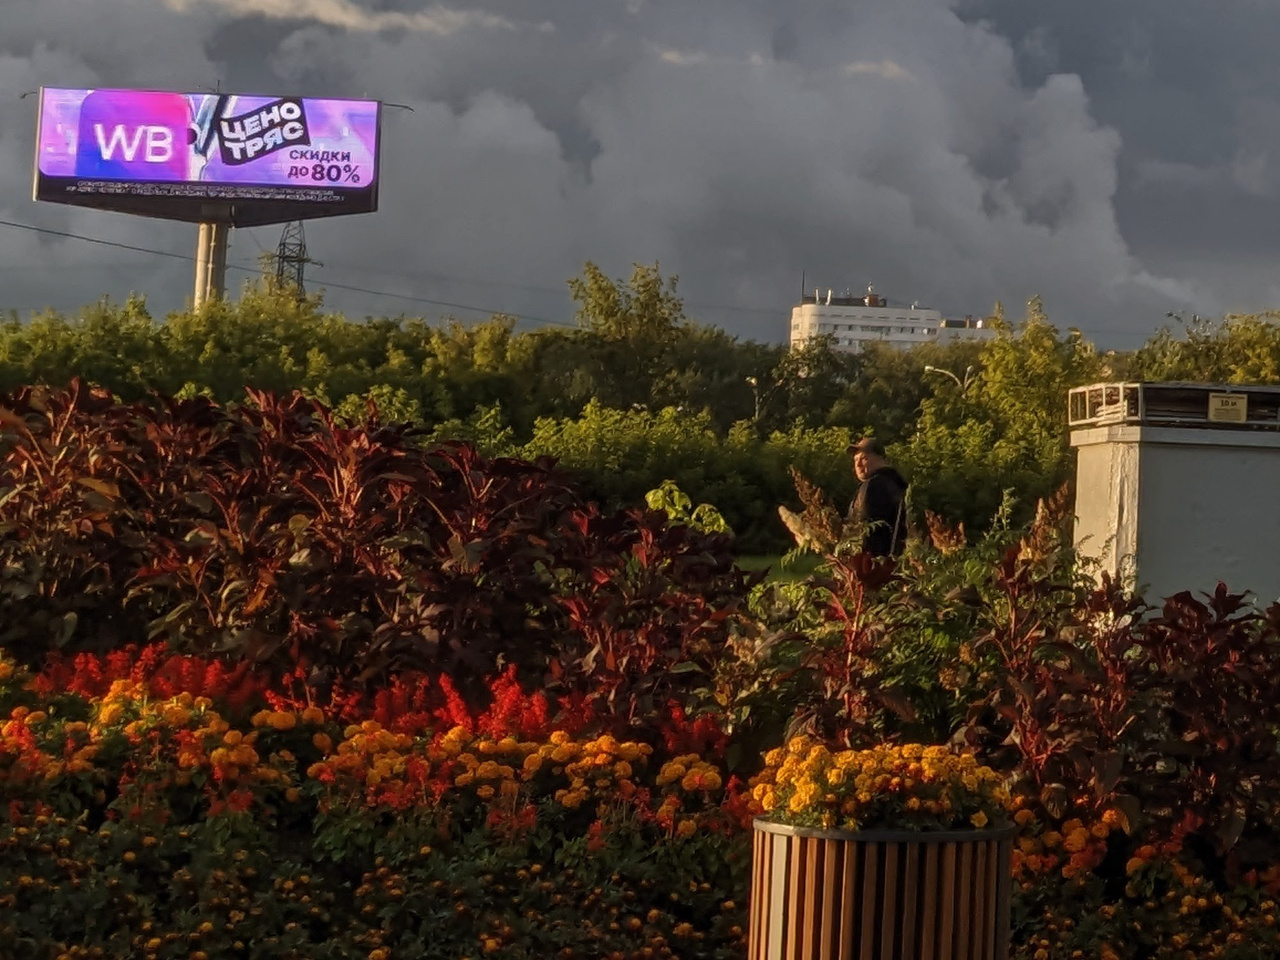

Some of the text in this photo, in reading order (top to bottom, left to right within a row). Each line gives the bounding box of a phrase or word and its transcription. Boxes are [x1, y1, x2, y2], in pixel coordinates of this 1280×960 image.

[220, 102, 301, 141] ЦЕНО
[224, 121, 304, 160] ТРЯС
[94, 123, 174, 163] WB
[311, 163, 360, 183] 80%
